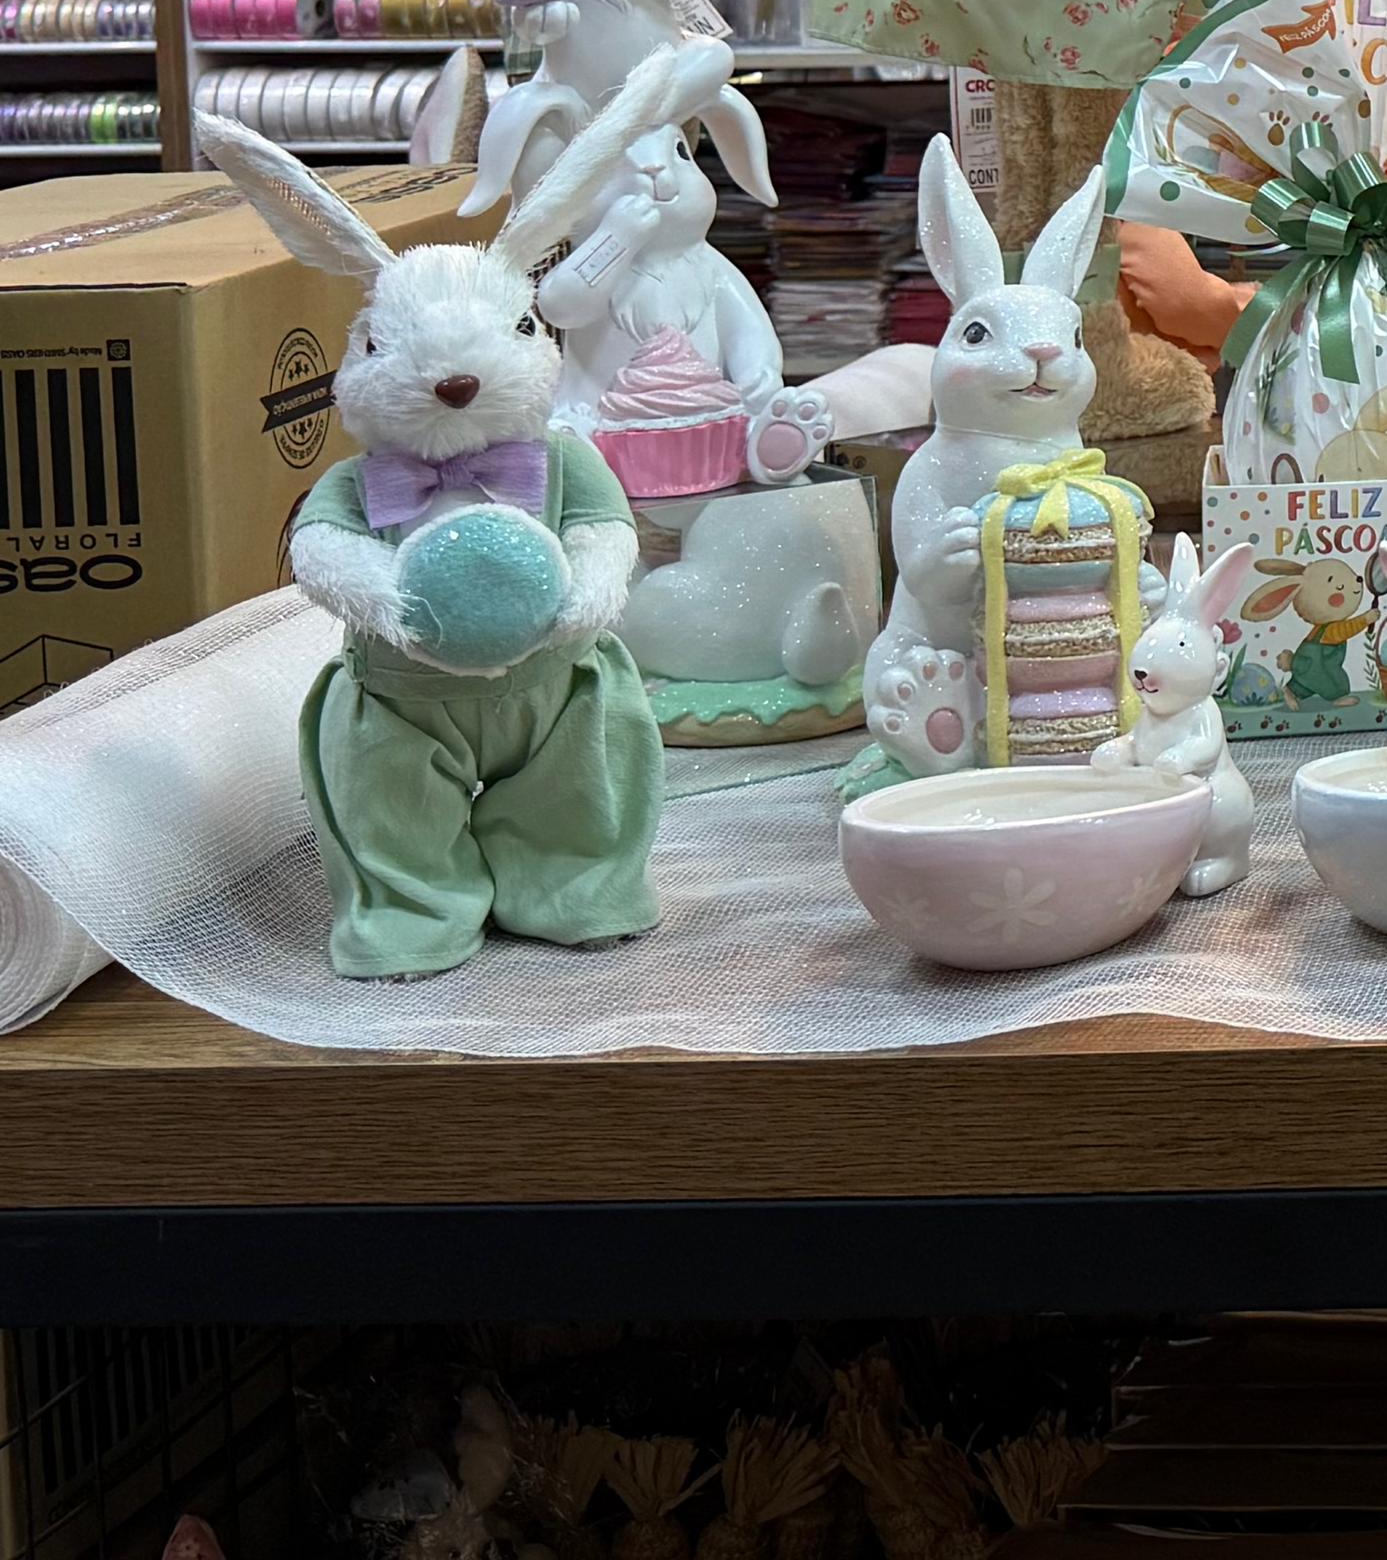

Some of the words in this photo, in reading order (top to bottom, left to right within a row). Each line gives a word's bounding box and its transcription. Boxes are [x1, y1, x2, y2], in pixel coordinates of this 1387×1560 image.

[965, 79, 995, 94] CRO
[968, 167, 999, 185] CONT
[1287, 486, 1384, 521] FELIZ
[5, 533, 142, 553] FLORAL
